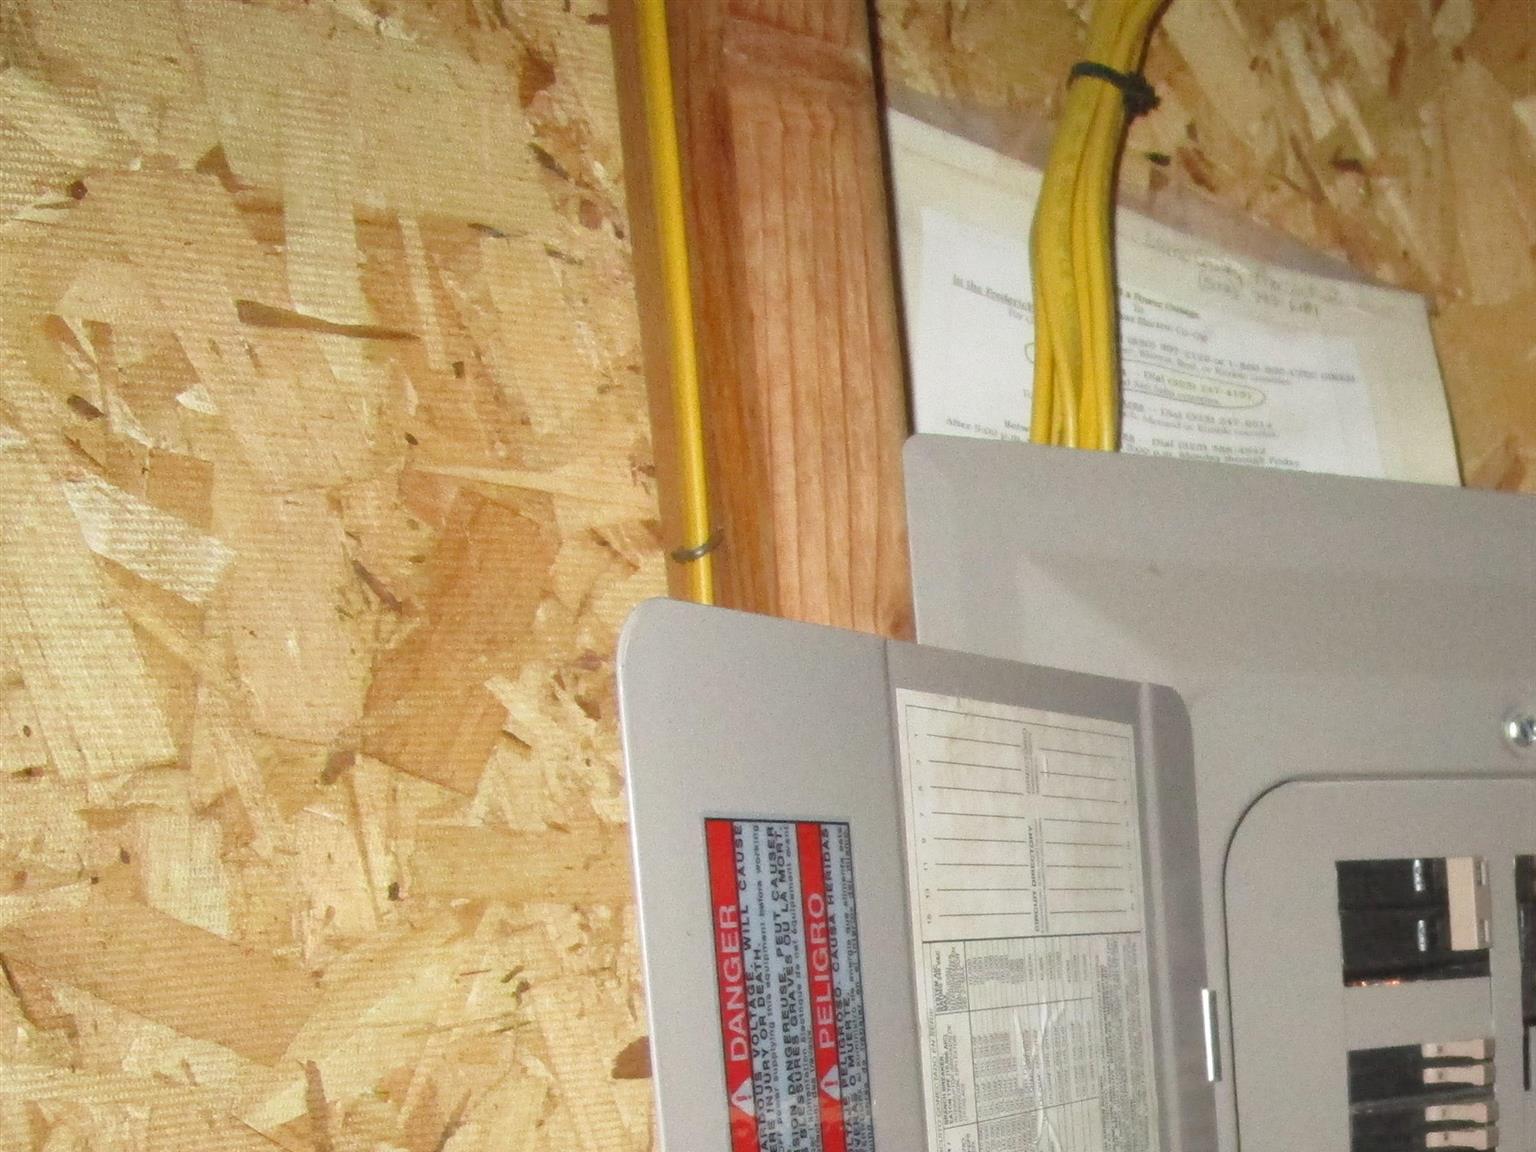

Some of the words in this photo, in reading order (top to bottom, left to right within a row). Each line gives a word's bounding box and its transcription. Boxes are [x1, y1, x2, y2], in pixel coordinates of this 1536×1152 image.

[733, 824, 746, 890] CAUSE
[752, 824, 762, 873] working
[766, 826, 779, 901] CAUSER
[775, 825, 786, 882] MORT.
[822, 828, 834, 904] HERIDAS
[1027, 825, 1036, 886] DIRECTORY
[740, 904, 751, 950] WILL
[756, 880, 766, 916] before
[780, 891, 788, 912] LA
[760, 922, 771, 988] equipment
[773, 910, 784, 957] PEUT
[782, 920, 791, 945] OU
[829, 914, 839, 972] CAUSA
[717, 904, 749, 1062] DANGER
[752, 943, 765, 1007] DEATH.
[785, 954, 798, 1027] GRAVES
[807, 892, 834, 1049] PELIGRO
[745, 963, 760, 1057] VOLTAGE.
[758, 1015, 768, 1040] OR
[778, 966, 795, 1095] DANGEREUSE.
[834, 981, 848, 1088] PELIGROSO.
[842, 992, 854, 1068] MUERTE.
[761, 1047, 774, 1112] INJURY
[768, 1021, 779, 1081] supplying
[848, 1074, 855, 1086] O
[774, 1086, 782, 1124] power
[792, 1035, 807, 1139] BLESSURES
